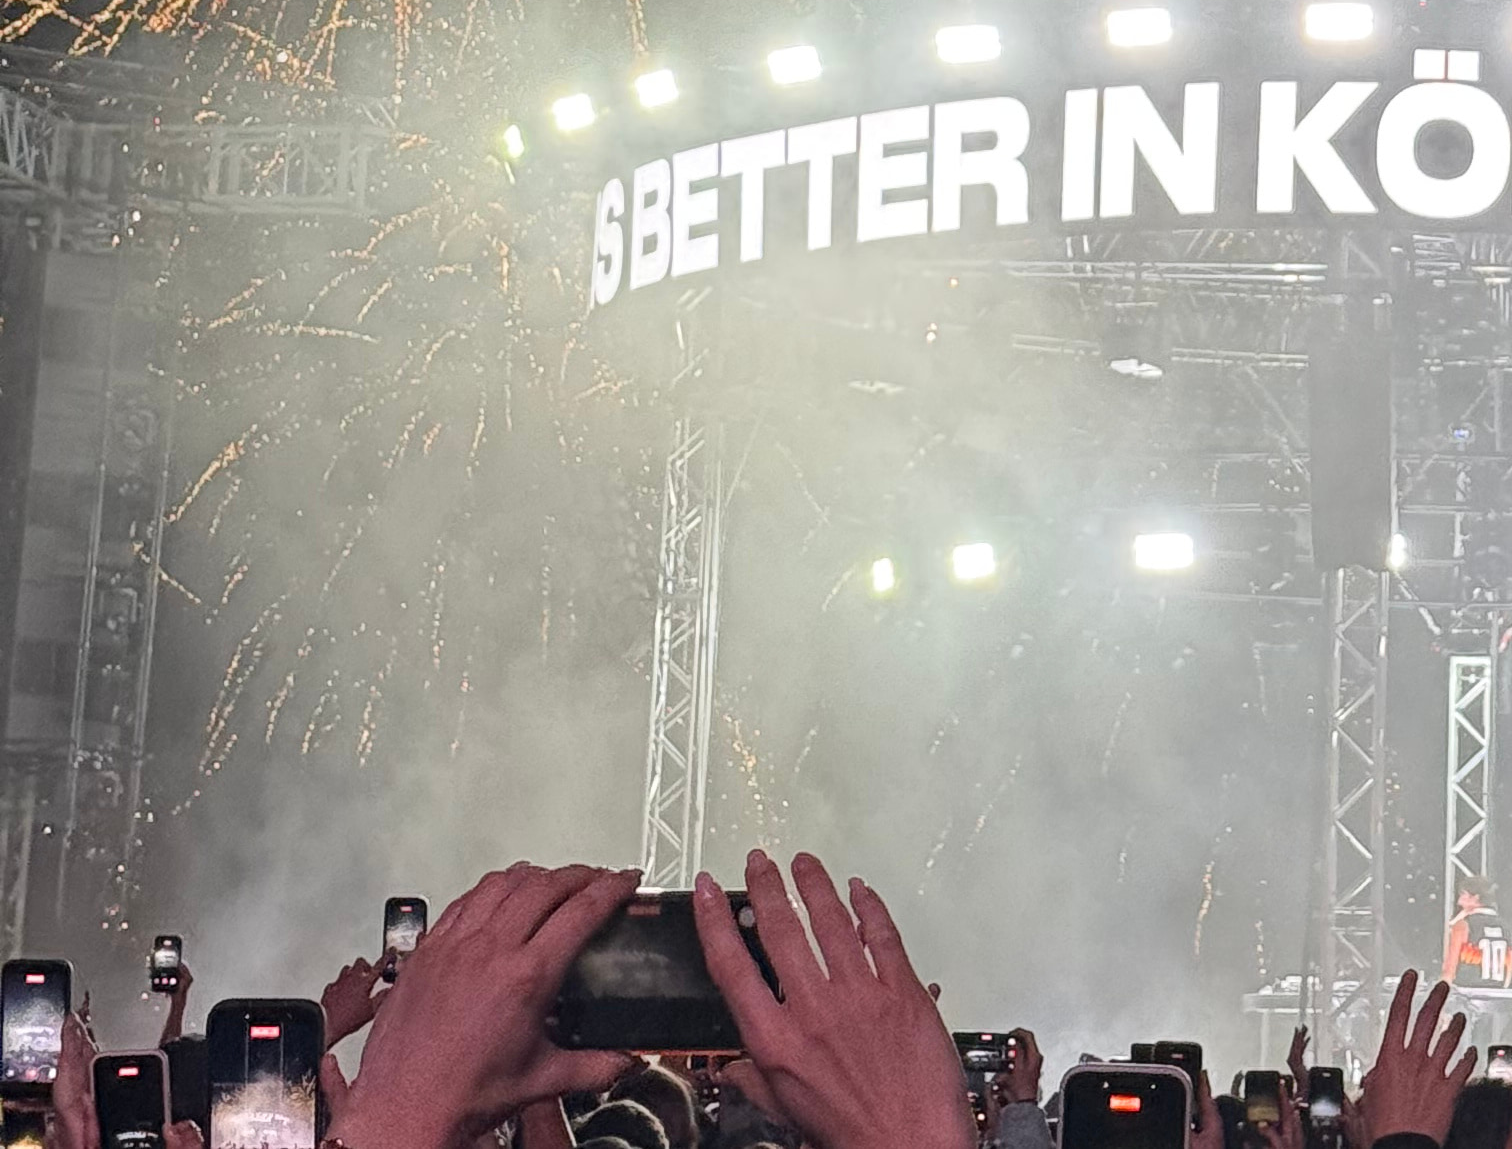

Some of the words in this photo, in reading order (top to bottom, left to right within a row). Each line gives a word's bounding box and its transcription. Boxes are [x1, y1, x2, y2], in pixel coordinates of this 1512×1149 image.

[629, 95, 1031, 291] BETTER
[1061, 81, 1221, 222] IN
[1478, 938, 1508, 981] 10
